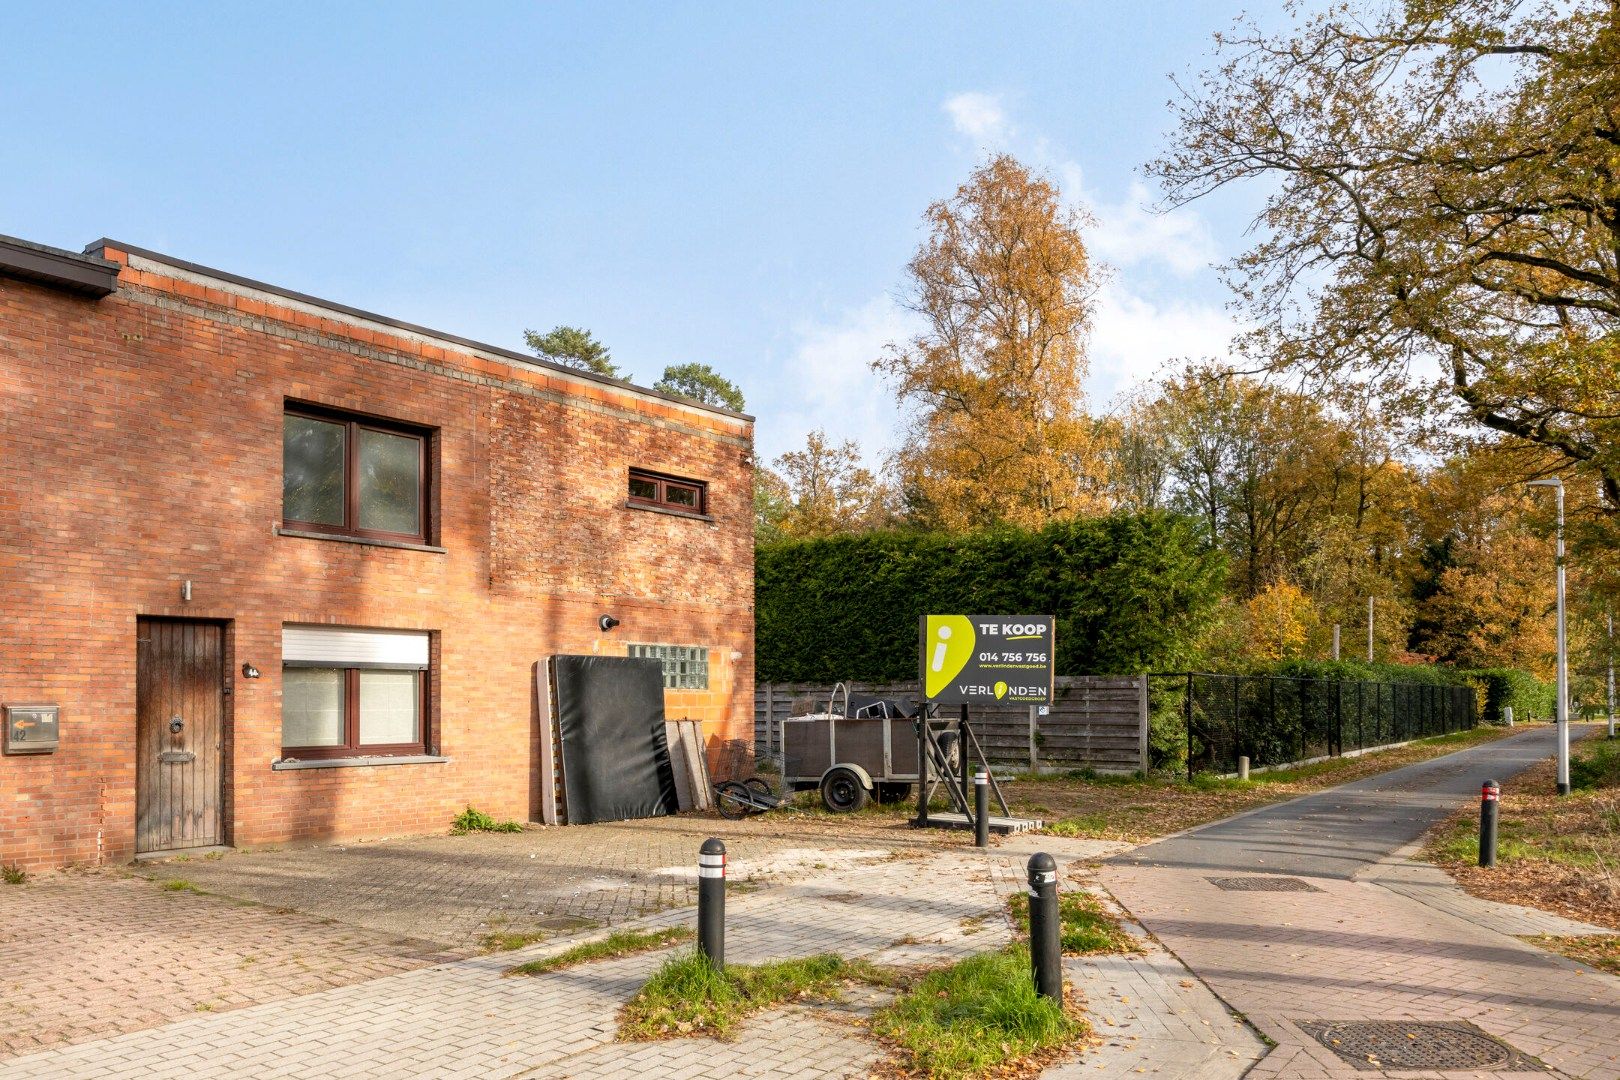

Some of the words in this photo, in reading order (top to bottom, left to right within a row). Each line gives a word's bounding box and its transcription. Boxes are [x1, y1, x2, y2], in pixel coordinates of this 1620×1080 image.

[979, 623, 999, 635] TE
[1002, 624, 1047, 635] KOOP
[979, 652, 998, 661] 014
[1002, 652, 1022, 662] 756
[1026, 652, 1047, 662] 756
[13, 730, 26, 742] 42
